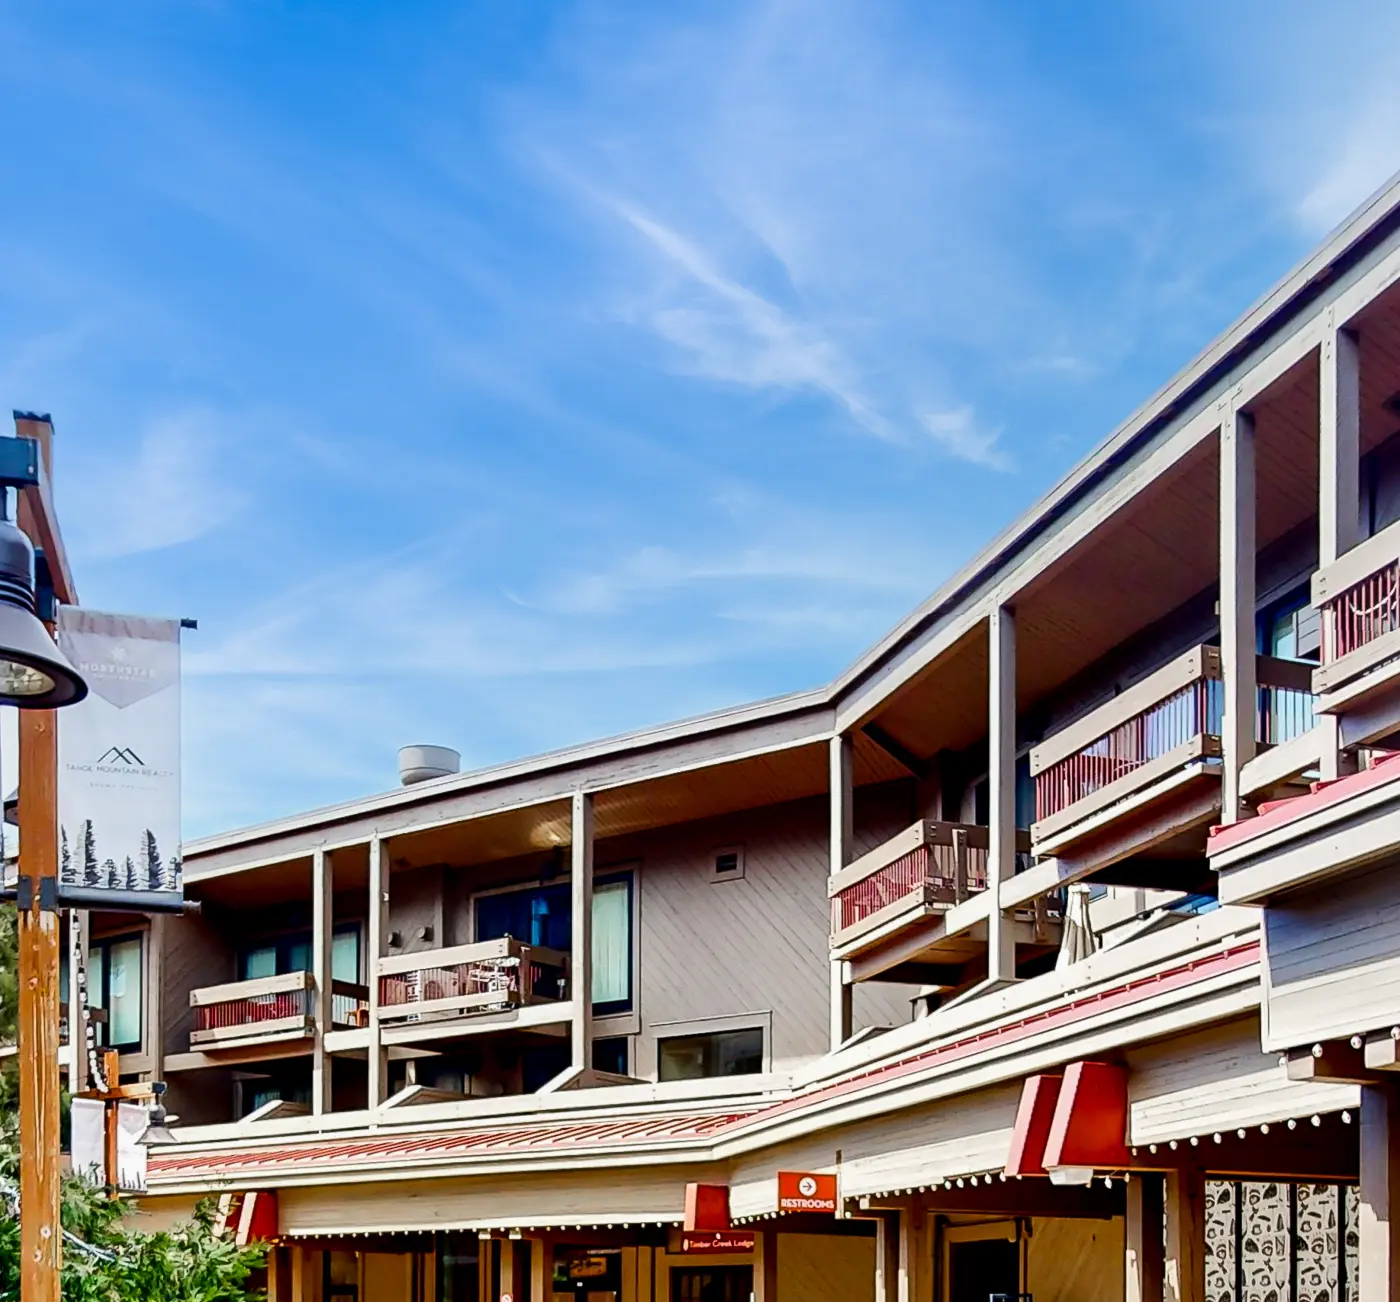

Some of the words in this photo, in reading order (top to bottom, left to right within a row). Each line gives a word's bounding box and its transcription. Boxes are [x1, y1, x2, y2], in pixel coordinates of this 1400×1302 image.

[66, 763, 93, 773] TAHOE
[97, 765, 139, 775] MOUNTAIN
[780, 1198, 835, 1210] RESTROOMS
[690, 1240, 711, 1248] Timber
[712, 1239, 732, 1248] Creek
[734, 1239, 755, 1249] Lodge
